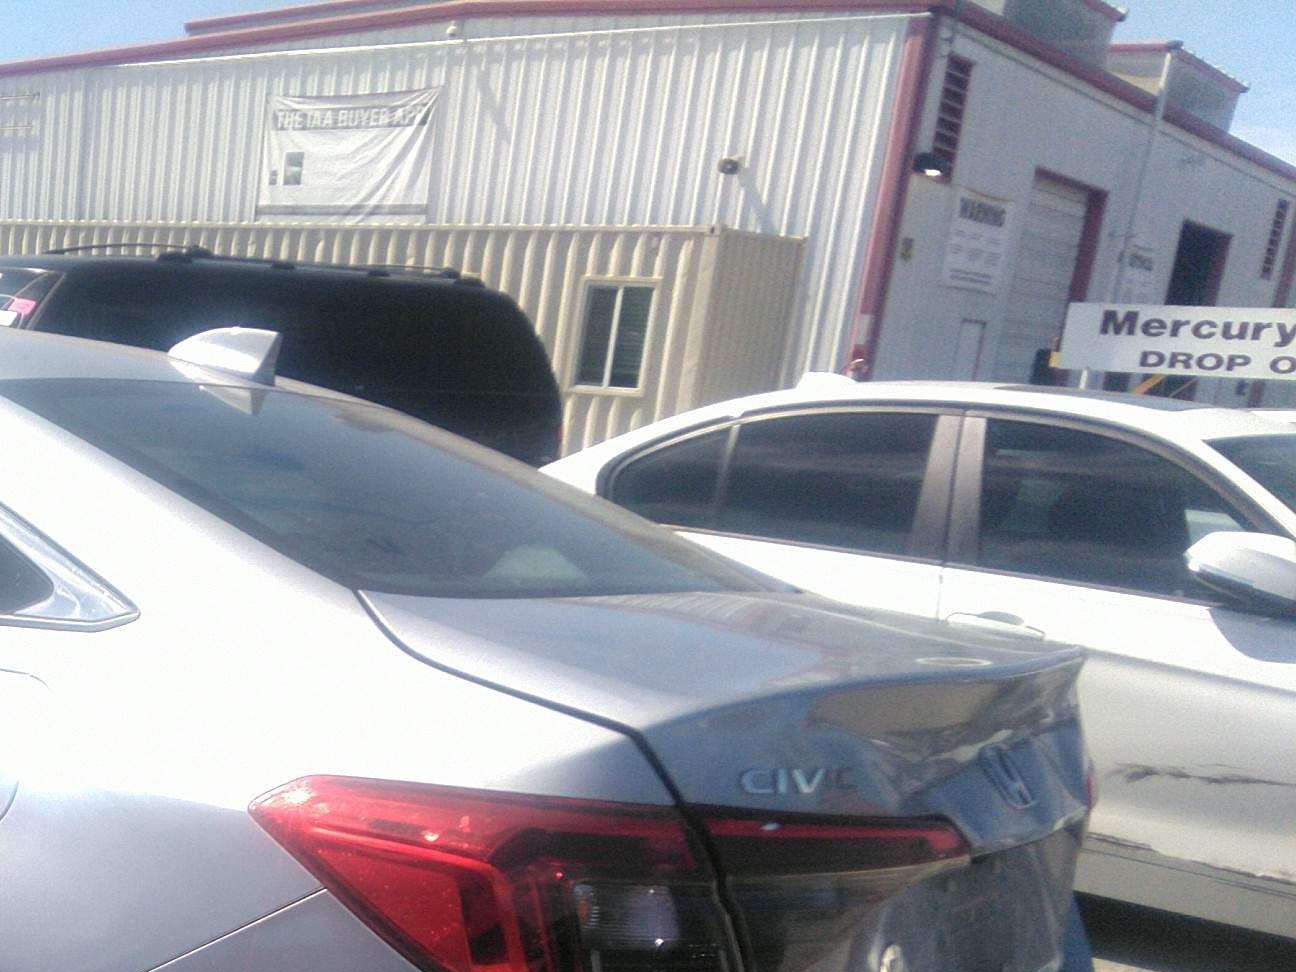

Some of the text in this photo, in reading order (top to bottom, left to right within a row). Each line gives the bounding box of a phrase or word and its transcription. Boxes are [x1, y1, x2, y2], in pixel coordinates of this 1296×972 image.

[336, 108, 388, 127] BUYER
[1098, 309, 1296, 348] Mercury
[1138, 350, 1253, 372] DROP
